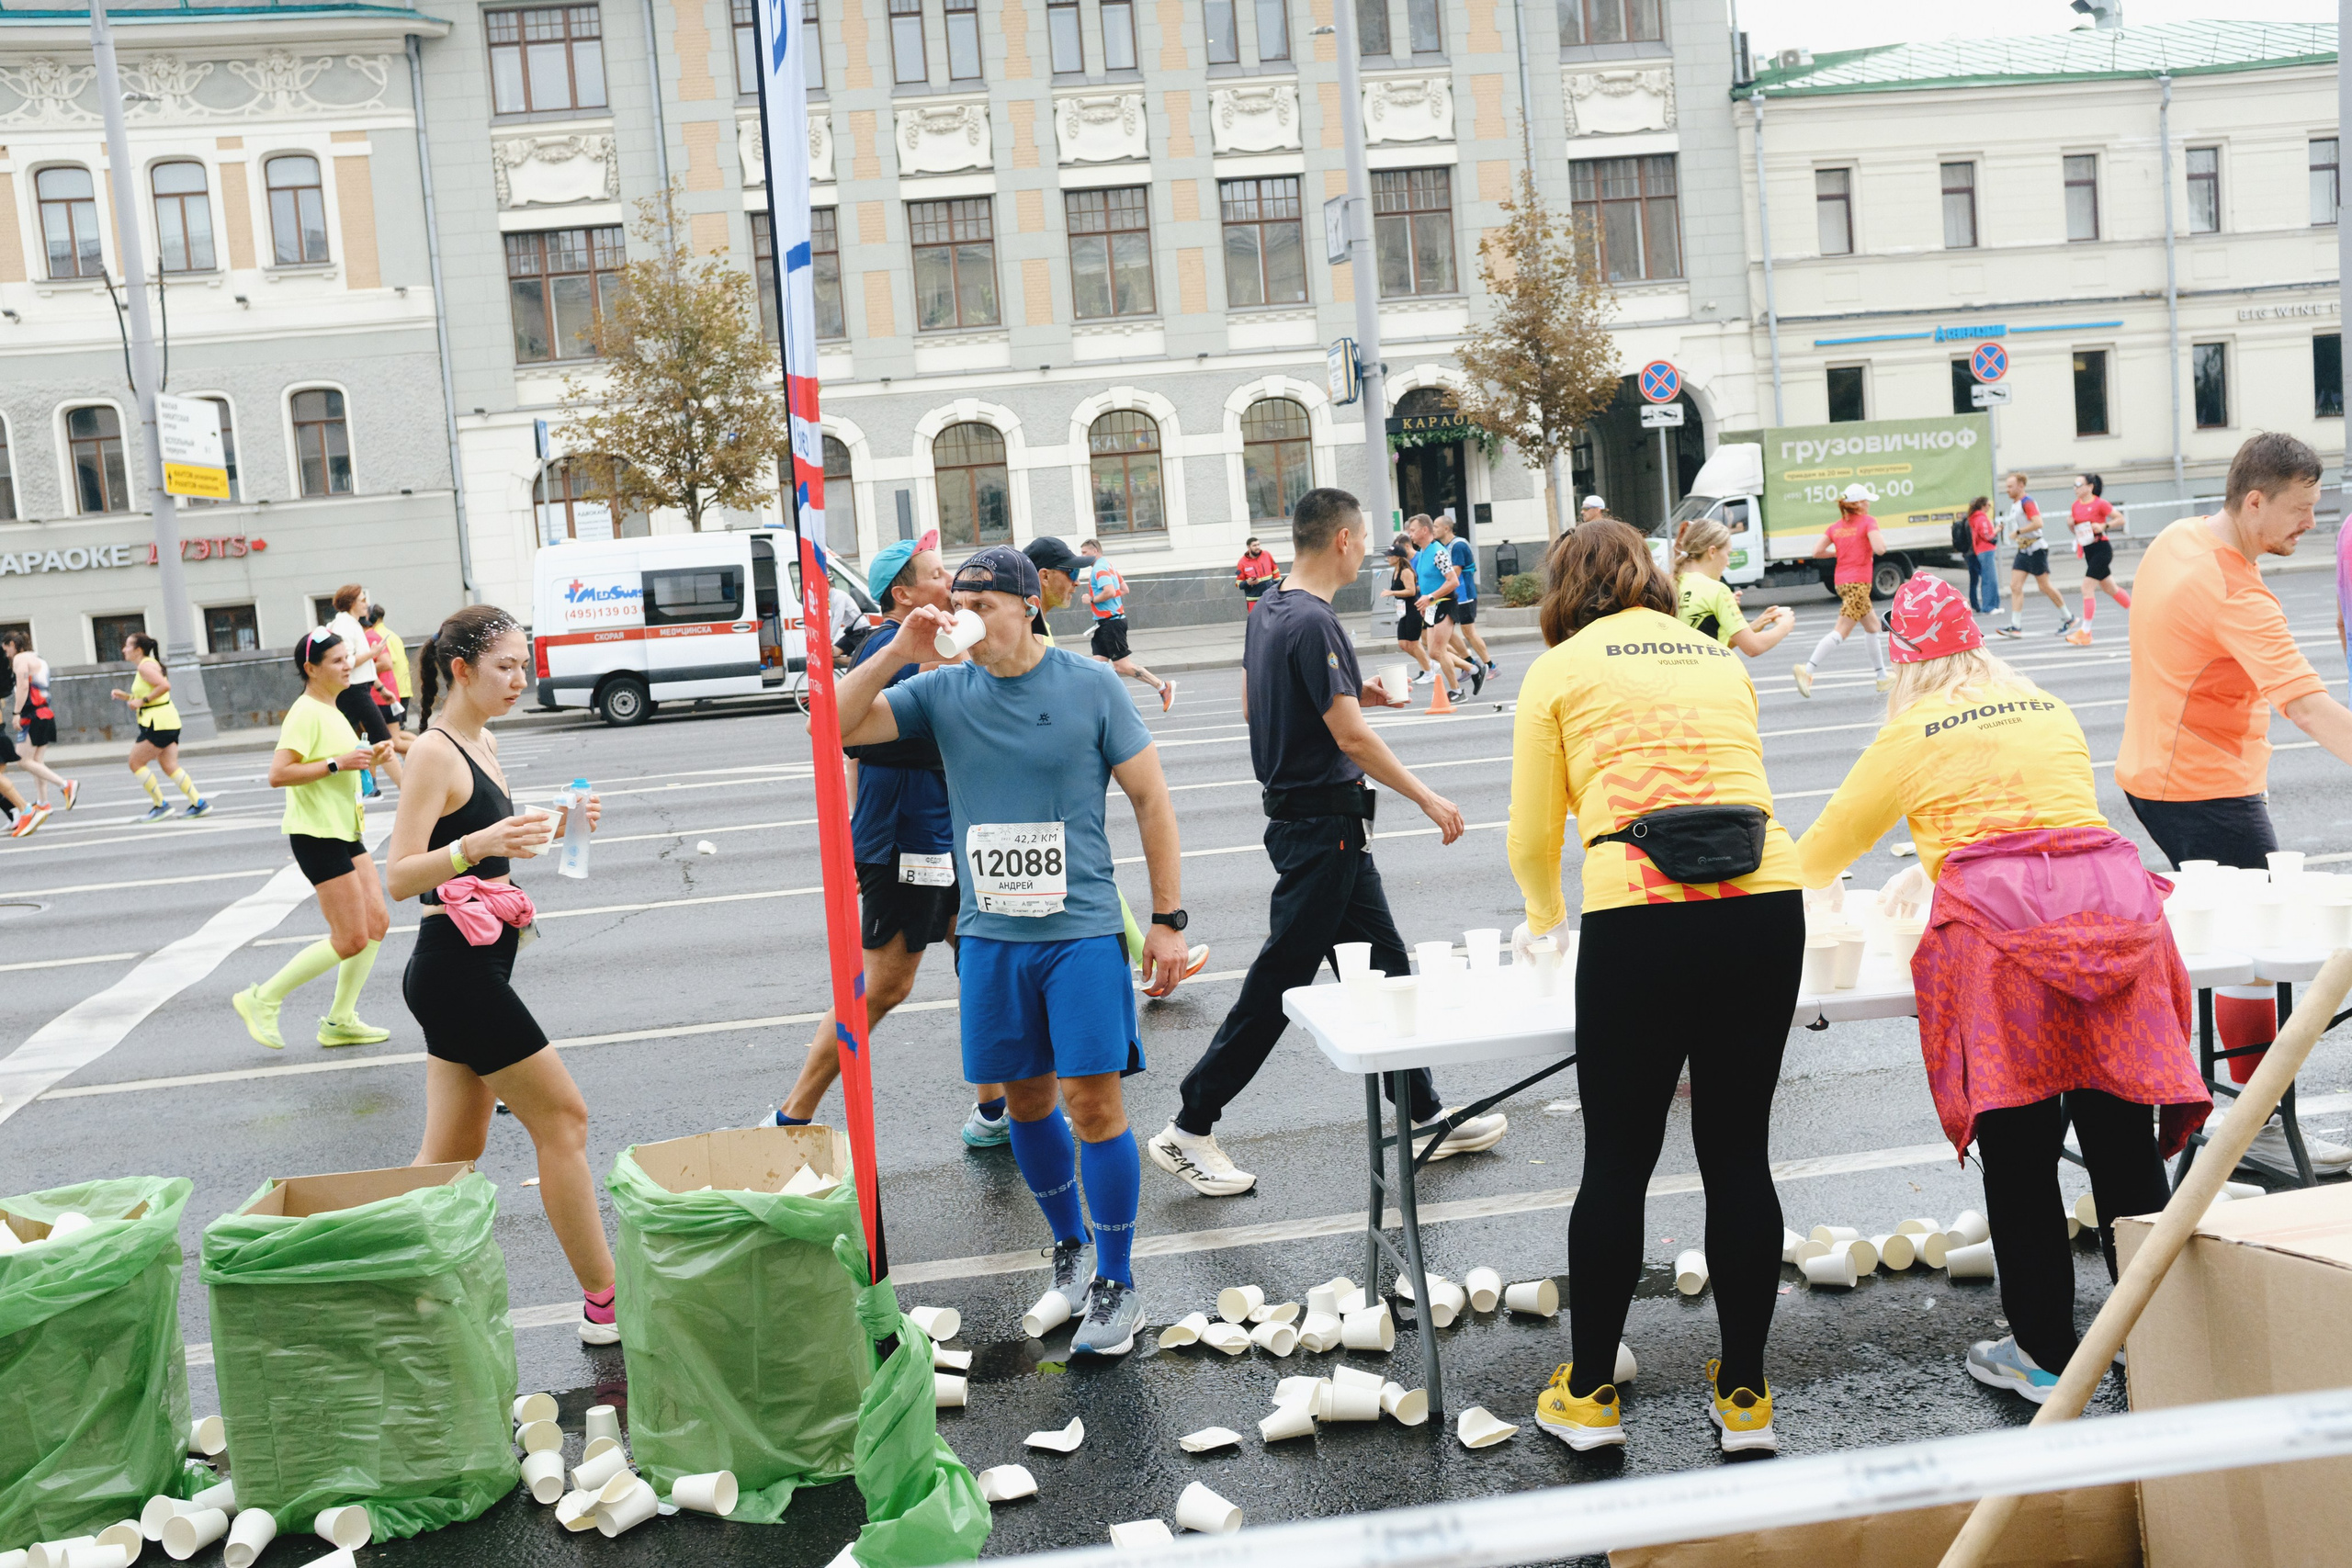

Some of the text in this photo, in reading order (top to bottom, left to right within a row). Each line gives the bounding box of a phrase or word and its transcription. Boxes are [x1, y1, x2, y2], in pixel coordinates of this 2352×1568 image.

[2237, 309, 2266, 321] BIG
[2275, 304, 2320, 318] WINE
[594, 631, 625, 642] СКОРАЯ
[1606, 642, 1731, 658] ВОЛОНТЁР
[1925, 698, 2056, 738] ВОЛОНТЁР
[1977, 716, 2023, 731] VOLUNTEER
[1014, 833, 1057, 844] 42,2 КМ
[971, 847, 1063, 877] 12088
[906, 870, 916, 883] B
[998, 880, 1034, 891] АНДРЕЙ
[983, 897, 992, 911] F
